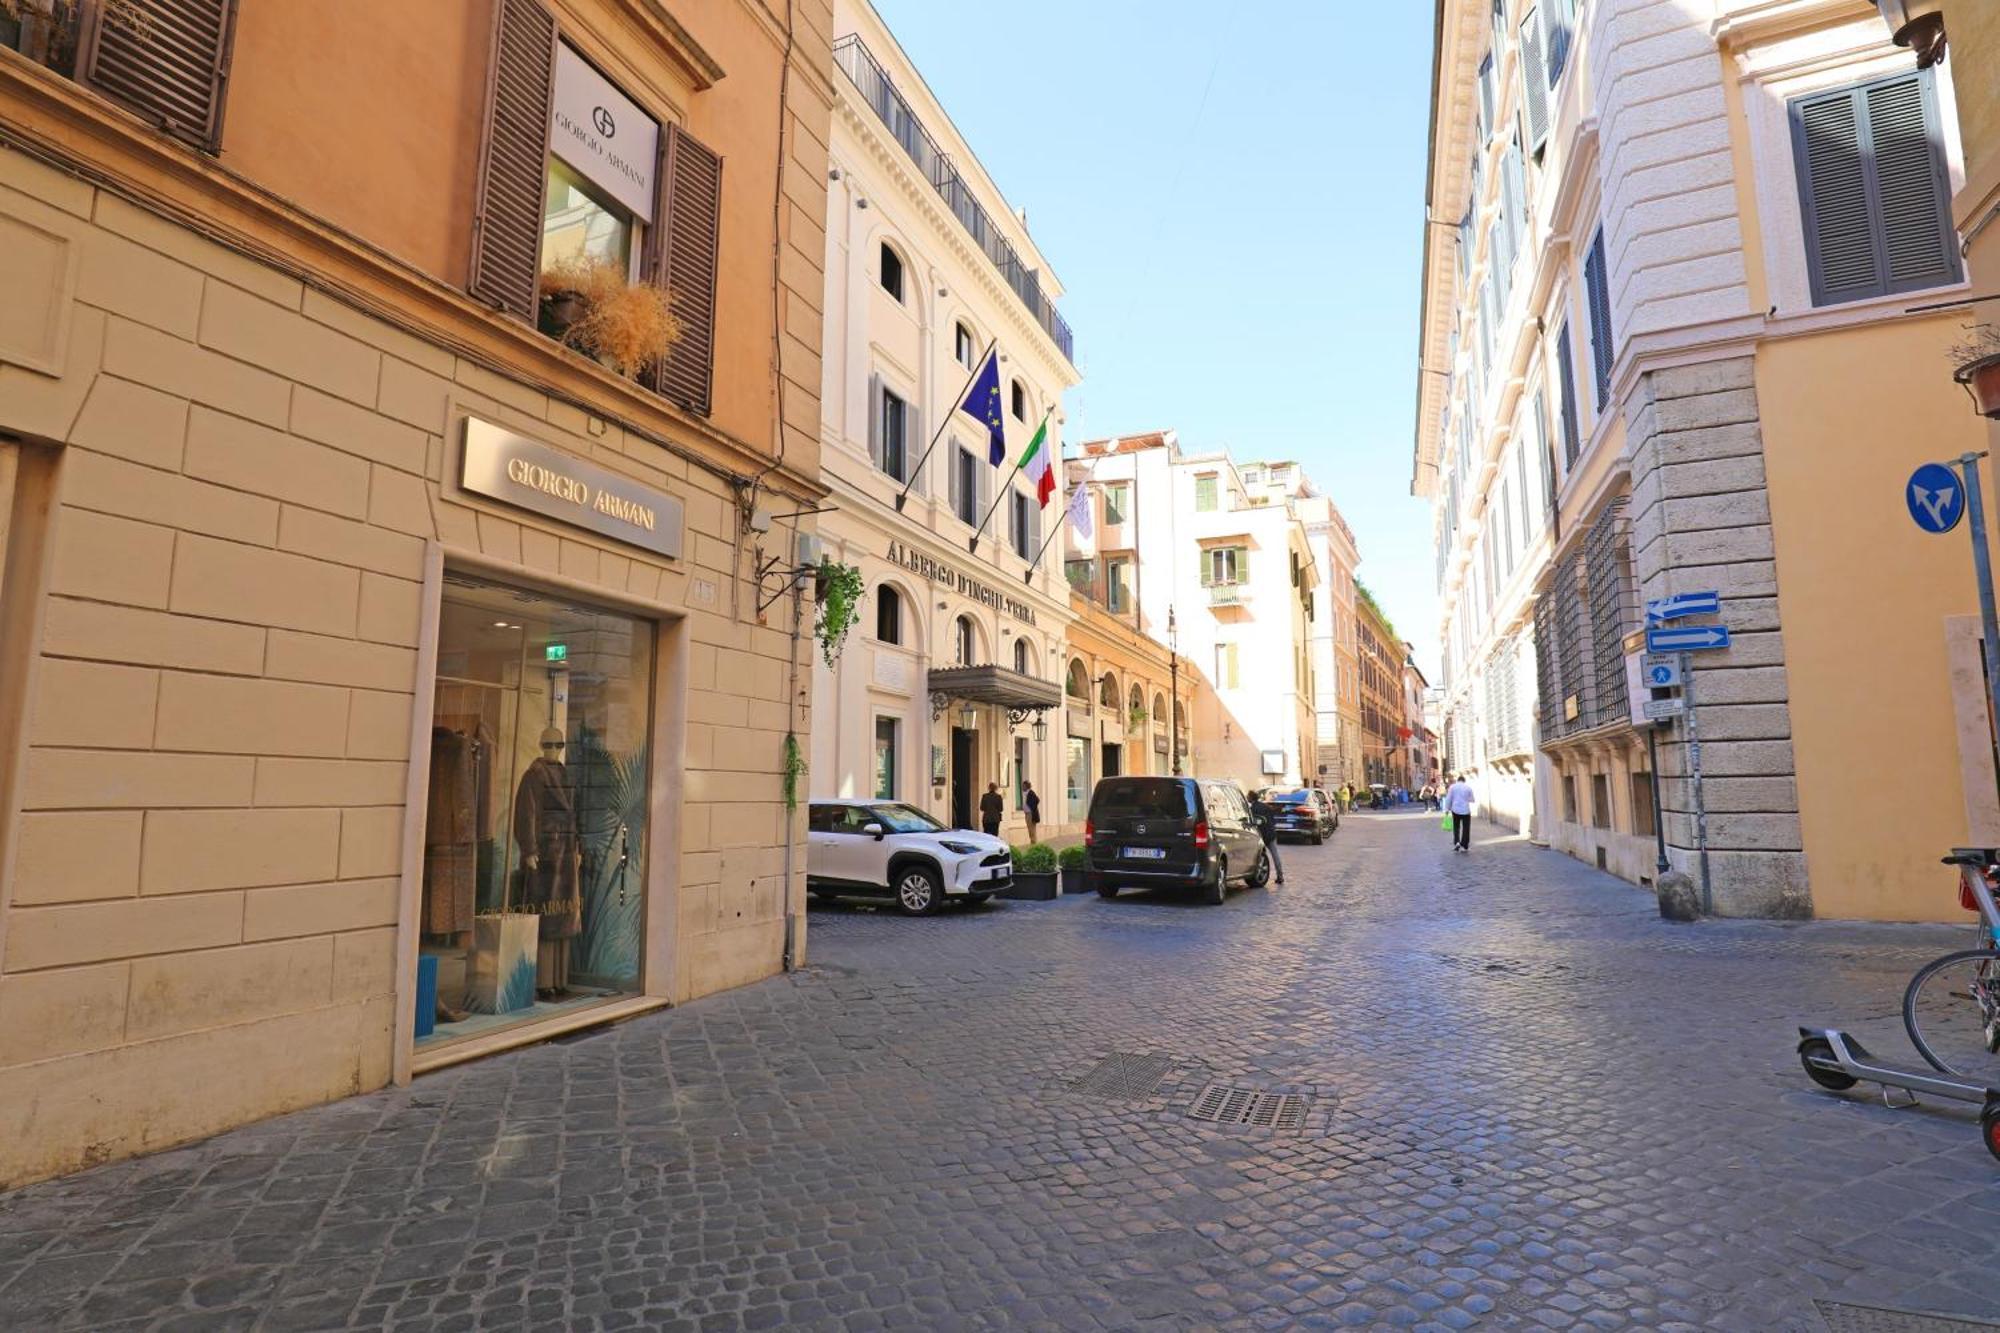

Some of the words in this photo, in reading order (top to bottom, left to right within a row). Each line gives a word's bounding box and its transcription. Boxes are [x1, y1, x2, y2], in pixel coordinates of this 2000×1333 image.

[555, 112, 603, 155] GIORGIO
[606, 152, 645, 188] ARMANI
[508, 458, 588, 505] GIORGIO
[593, 490, 656, 531] ARMANI
[886, 540, 955, 587] ALBERGO
[957, 573, 1037, 626] D'INGHILTERRA
